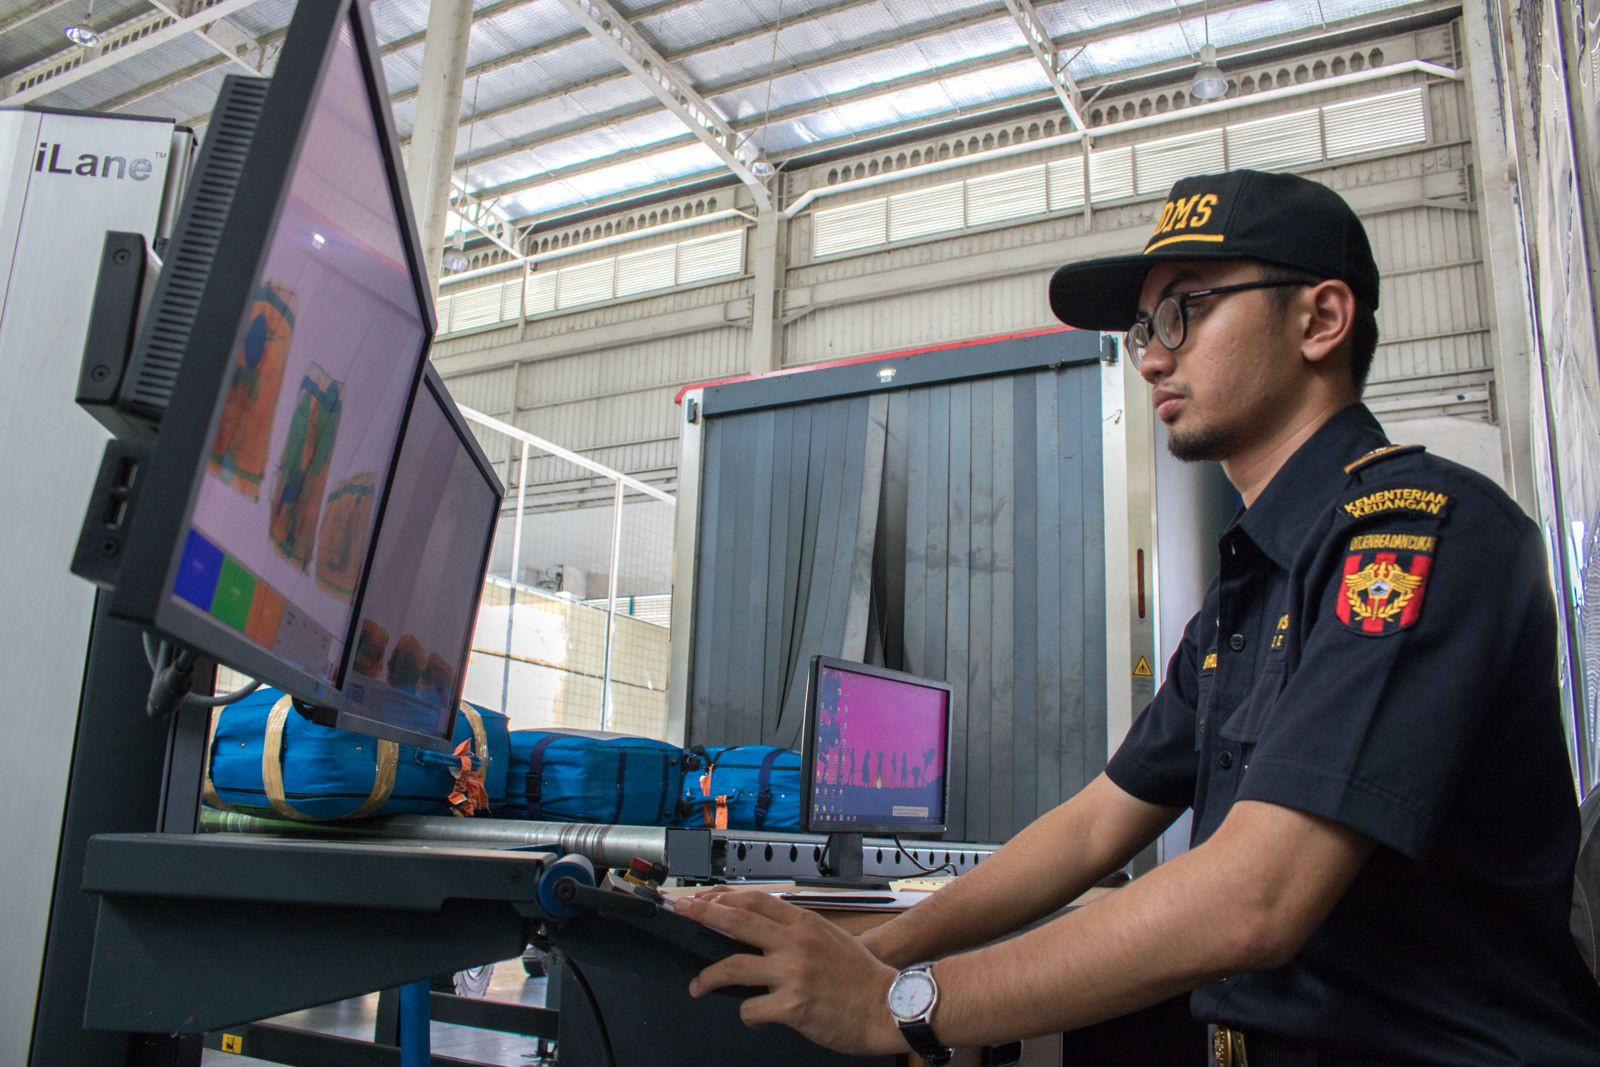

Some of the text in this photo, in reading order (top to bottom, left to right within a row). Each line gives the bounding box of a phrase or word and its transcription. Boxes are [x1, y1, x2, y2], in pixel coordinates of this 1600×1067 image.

[35, 142, 152, 181] iLane
[1152, 193, 1219, 237] OMS
[1344, 488, 1448, 513] KEMENTERIAN
[1352, 499, 1440, 518] KEUANGAN
